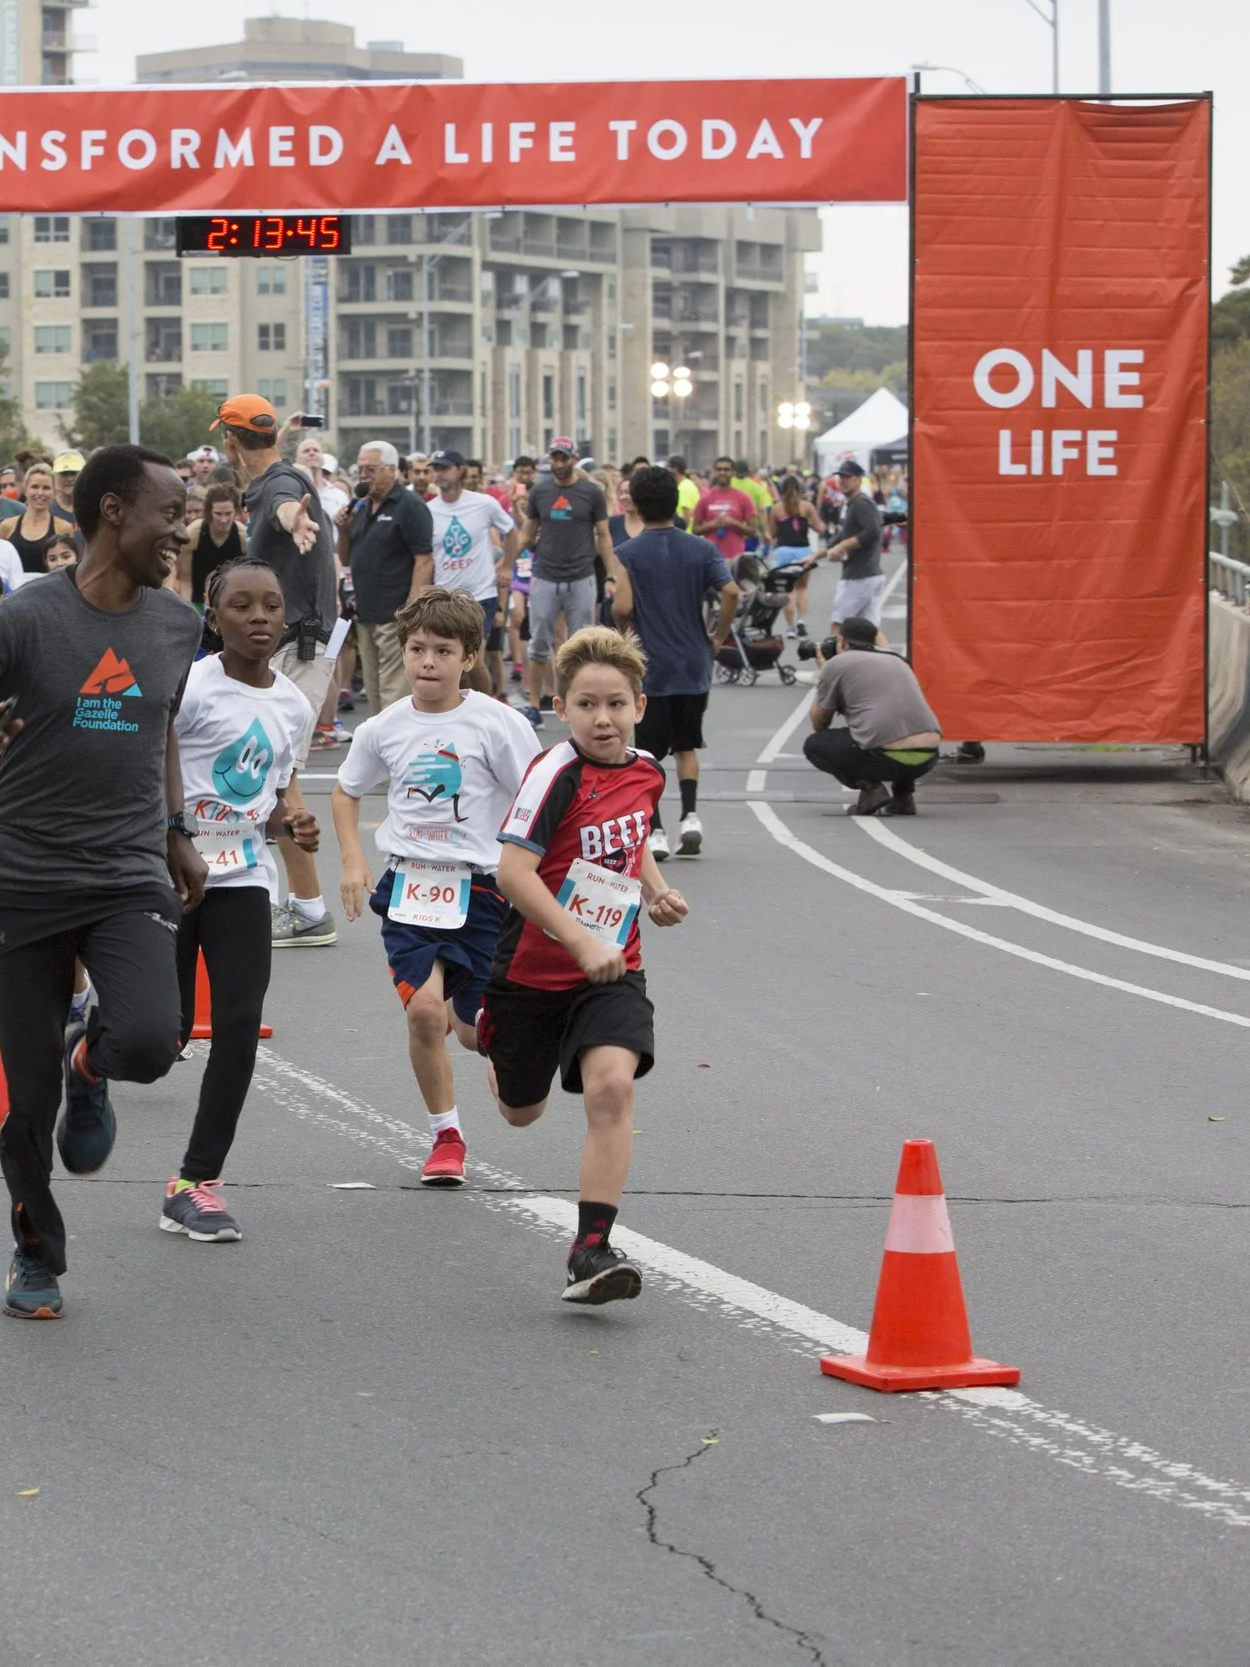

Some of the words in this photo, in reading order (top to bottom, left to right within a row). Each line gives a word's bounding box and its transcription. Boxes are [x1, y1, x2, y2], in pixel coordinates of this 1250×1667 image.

[375, 124, 412, 166] A
[444, 121, 577, 165] LIFE
[609, 117, 824, 160] TODAY
[973, 348, 1145, 409] ONE
[998, 429, 1118, 476] LIFE
[76, 696, 81, 708] I
[83, 699, 101, 708] am
[103, 698, 122, 709] the
[75, 707, 118, 720] Gazelle
[73, 717, 139, 732] Foundation
[579, 810, 646, 862] BEEF
[200, 850, 238, 866] -41
[411, 862, 426, 870] RUN
[431, 864, 456, 872] WATER
[406, 883, 455, 903] K-90
[587, 872, 606, 885] RUN
[609, 882, 629, 894] WATER
[568, 894, 623, 928] K-119
